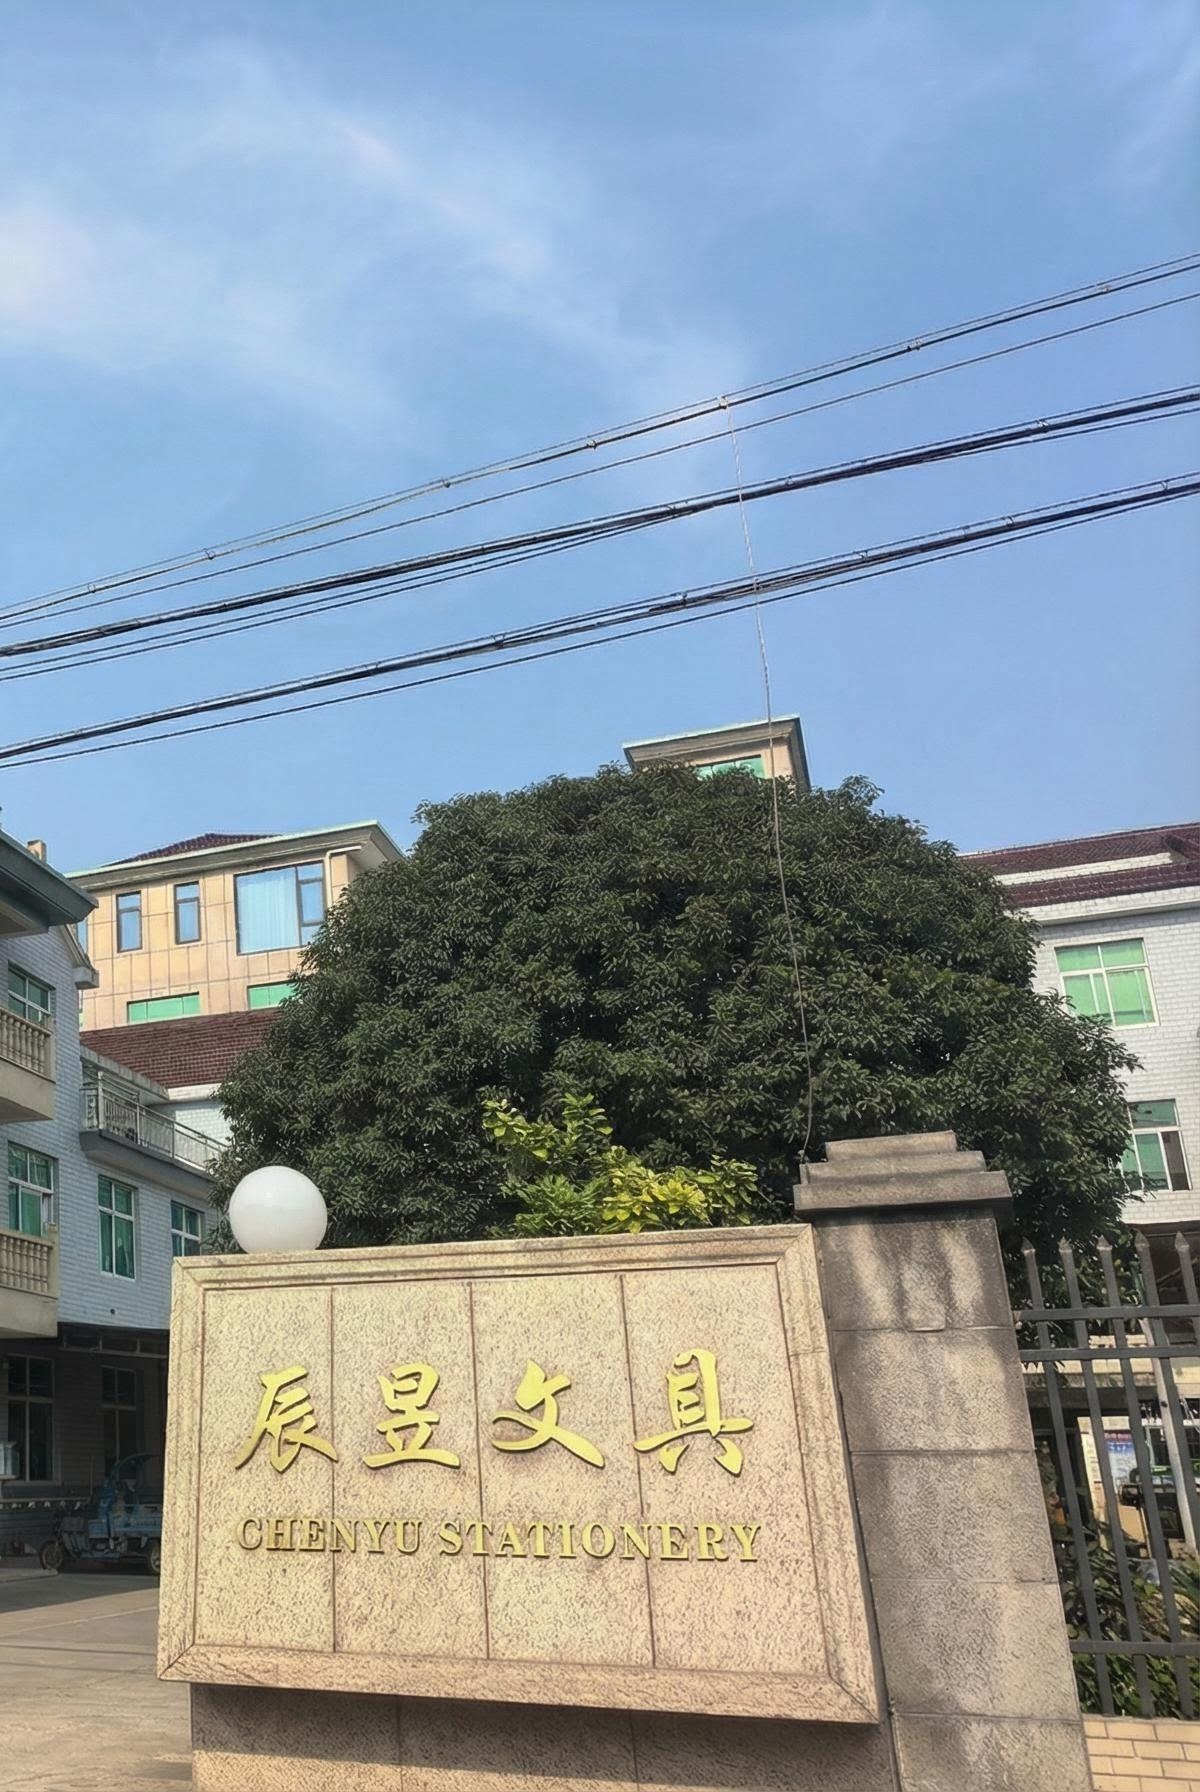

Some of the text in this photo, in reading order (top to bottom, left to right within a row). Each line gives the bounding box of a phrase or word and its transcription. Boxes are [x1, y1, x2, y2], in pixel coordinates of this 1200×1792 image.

[235, 1349, 755, 1476] 辰昱文具
[235, 1516, 762, 1562] CHENYU STATIONERY
